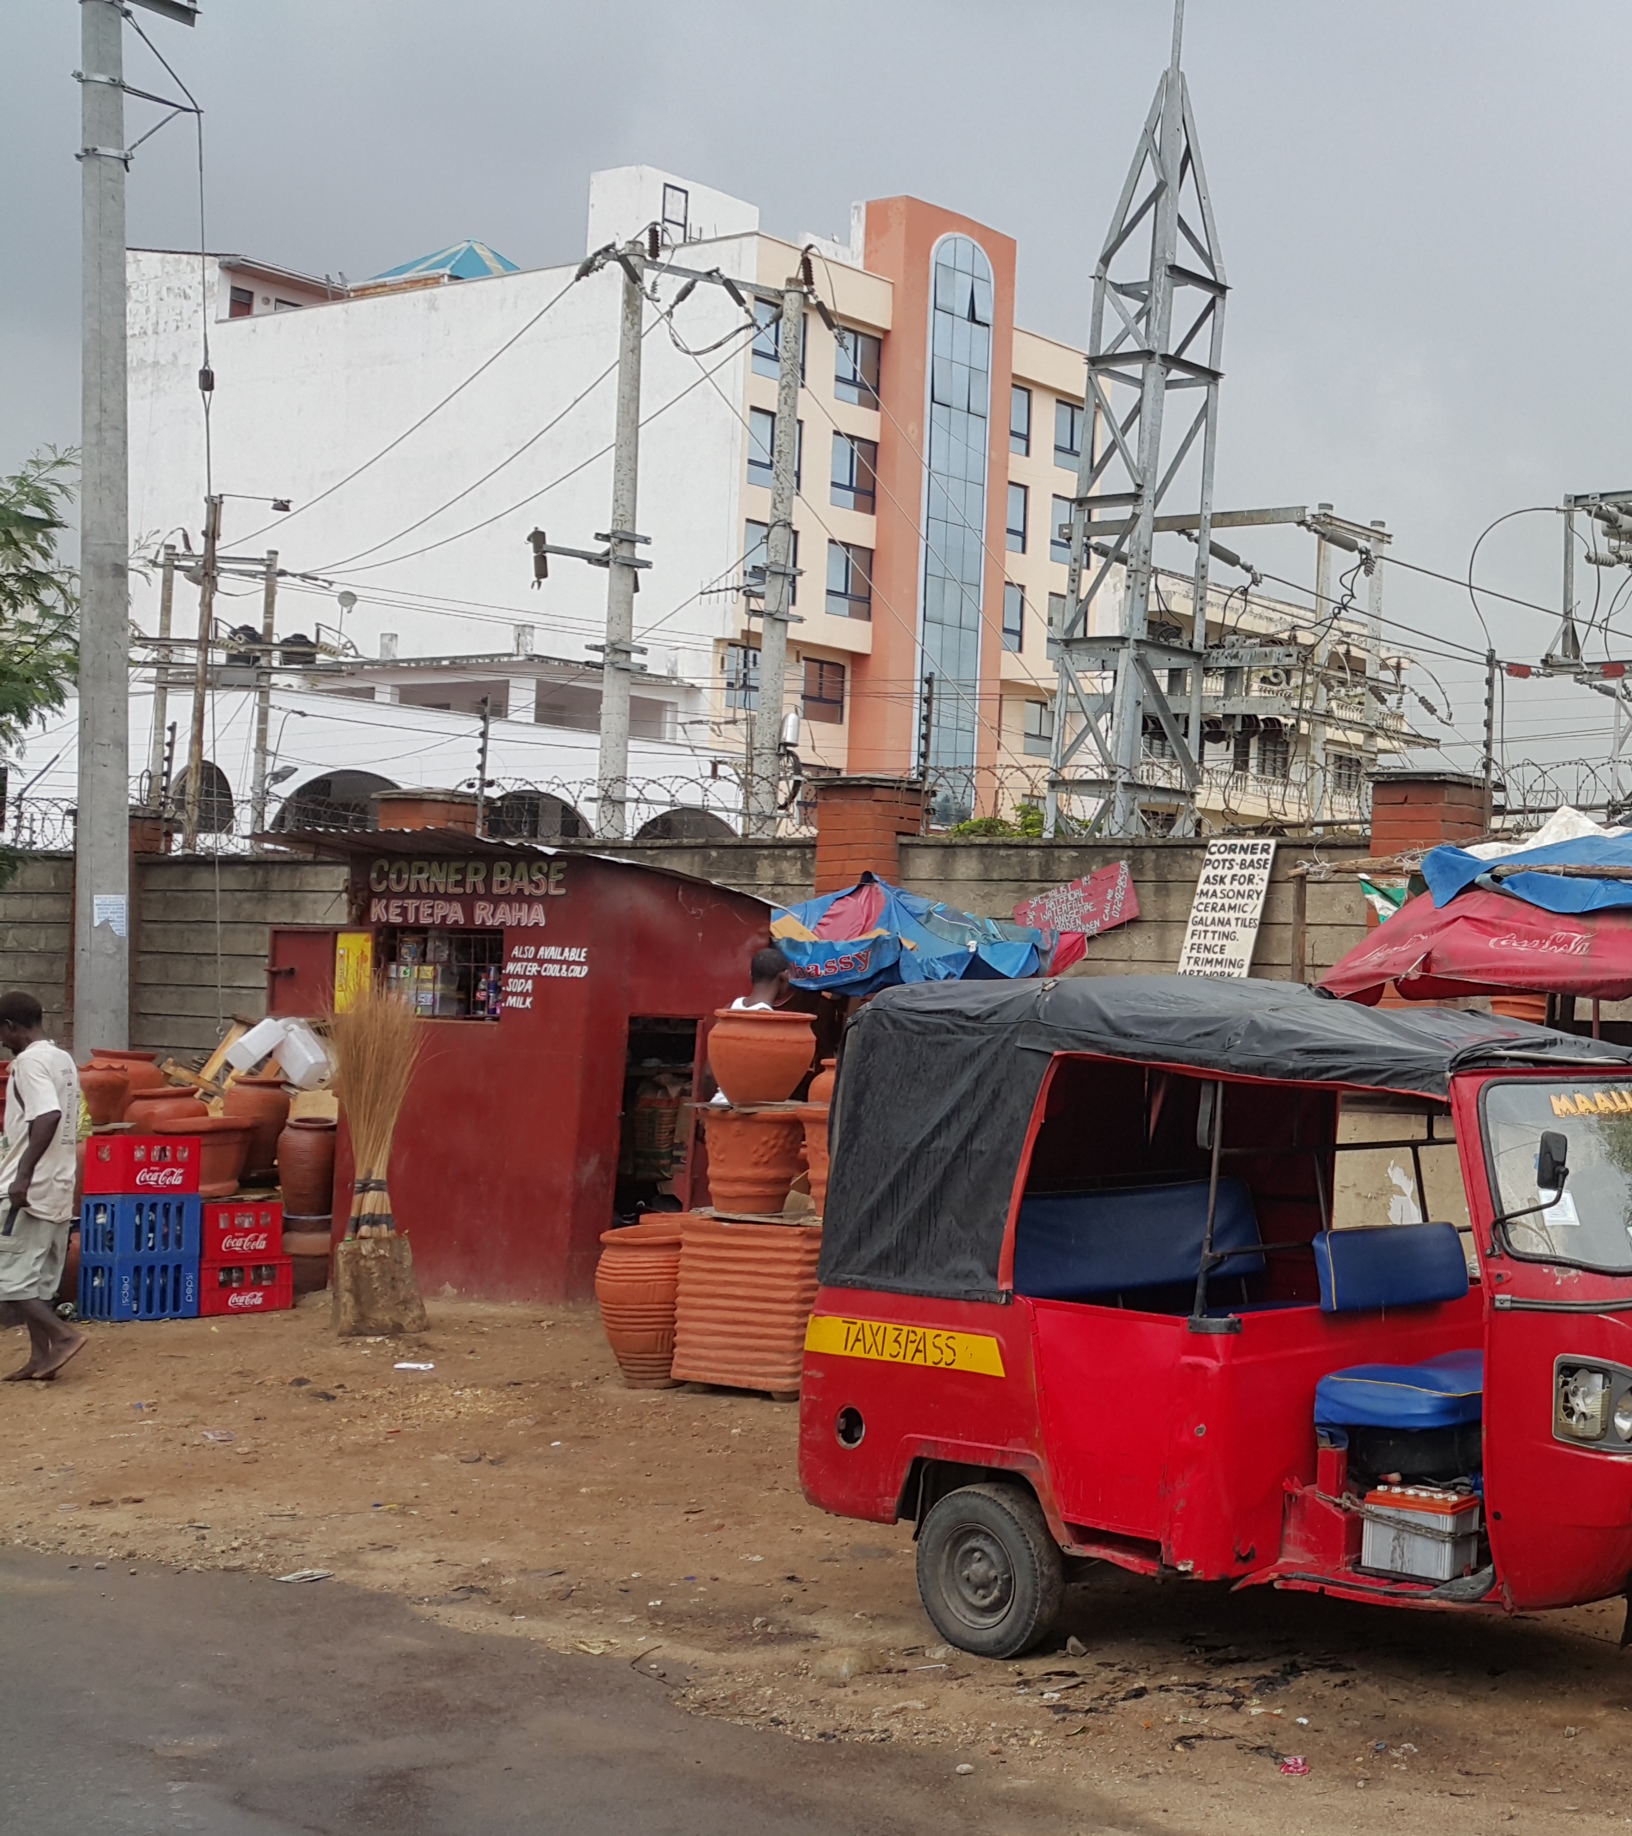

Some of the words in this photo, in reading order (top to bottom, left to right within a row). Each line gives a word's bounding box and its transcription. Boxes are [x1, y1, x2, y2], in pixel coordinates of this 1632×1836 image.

[1208, 843, 1271, 855] CORNER
[369, 858, 486, 895] CORNER
[491, 861, 568, 896] BASE
[1203, 874, 1227, 885] ASK
[1198, 889, 1263, 900] MASONRY
[370, 899, 464, 925] KETEPA
[474, 901, 546, 927] RAHA
[1196, 902, 1249, 914] CERAMIC
[1191, 915, 1232, 927] GALANA
[1235, 917, 1258, 929] TILES
[510, 946, 535, 959] ALSO
[537, 946, 588, 962] AVAILABLE
[1189, 943, 1226, 955] FENCE
[788, 949, 872, 980] bassy
[1186, 956, 1245, 969] TRIMMING
[121, 1275, 130, 1306] pepsi
[185, 1272, 194, 1302] pepsi
